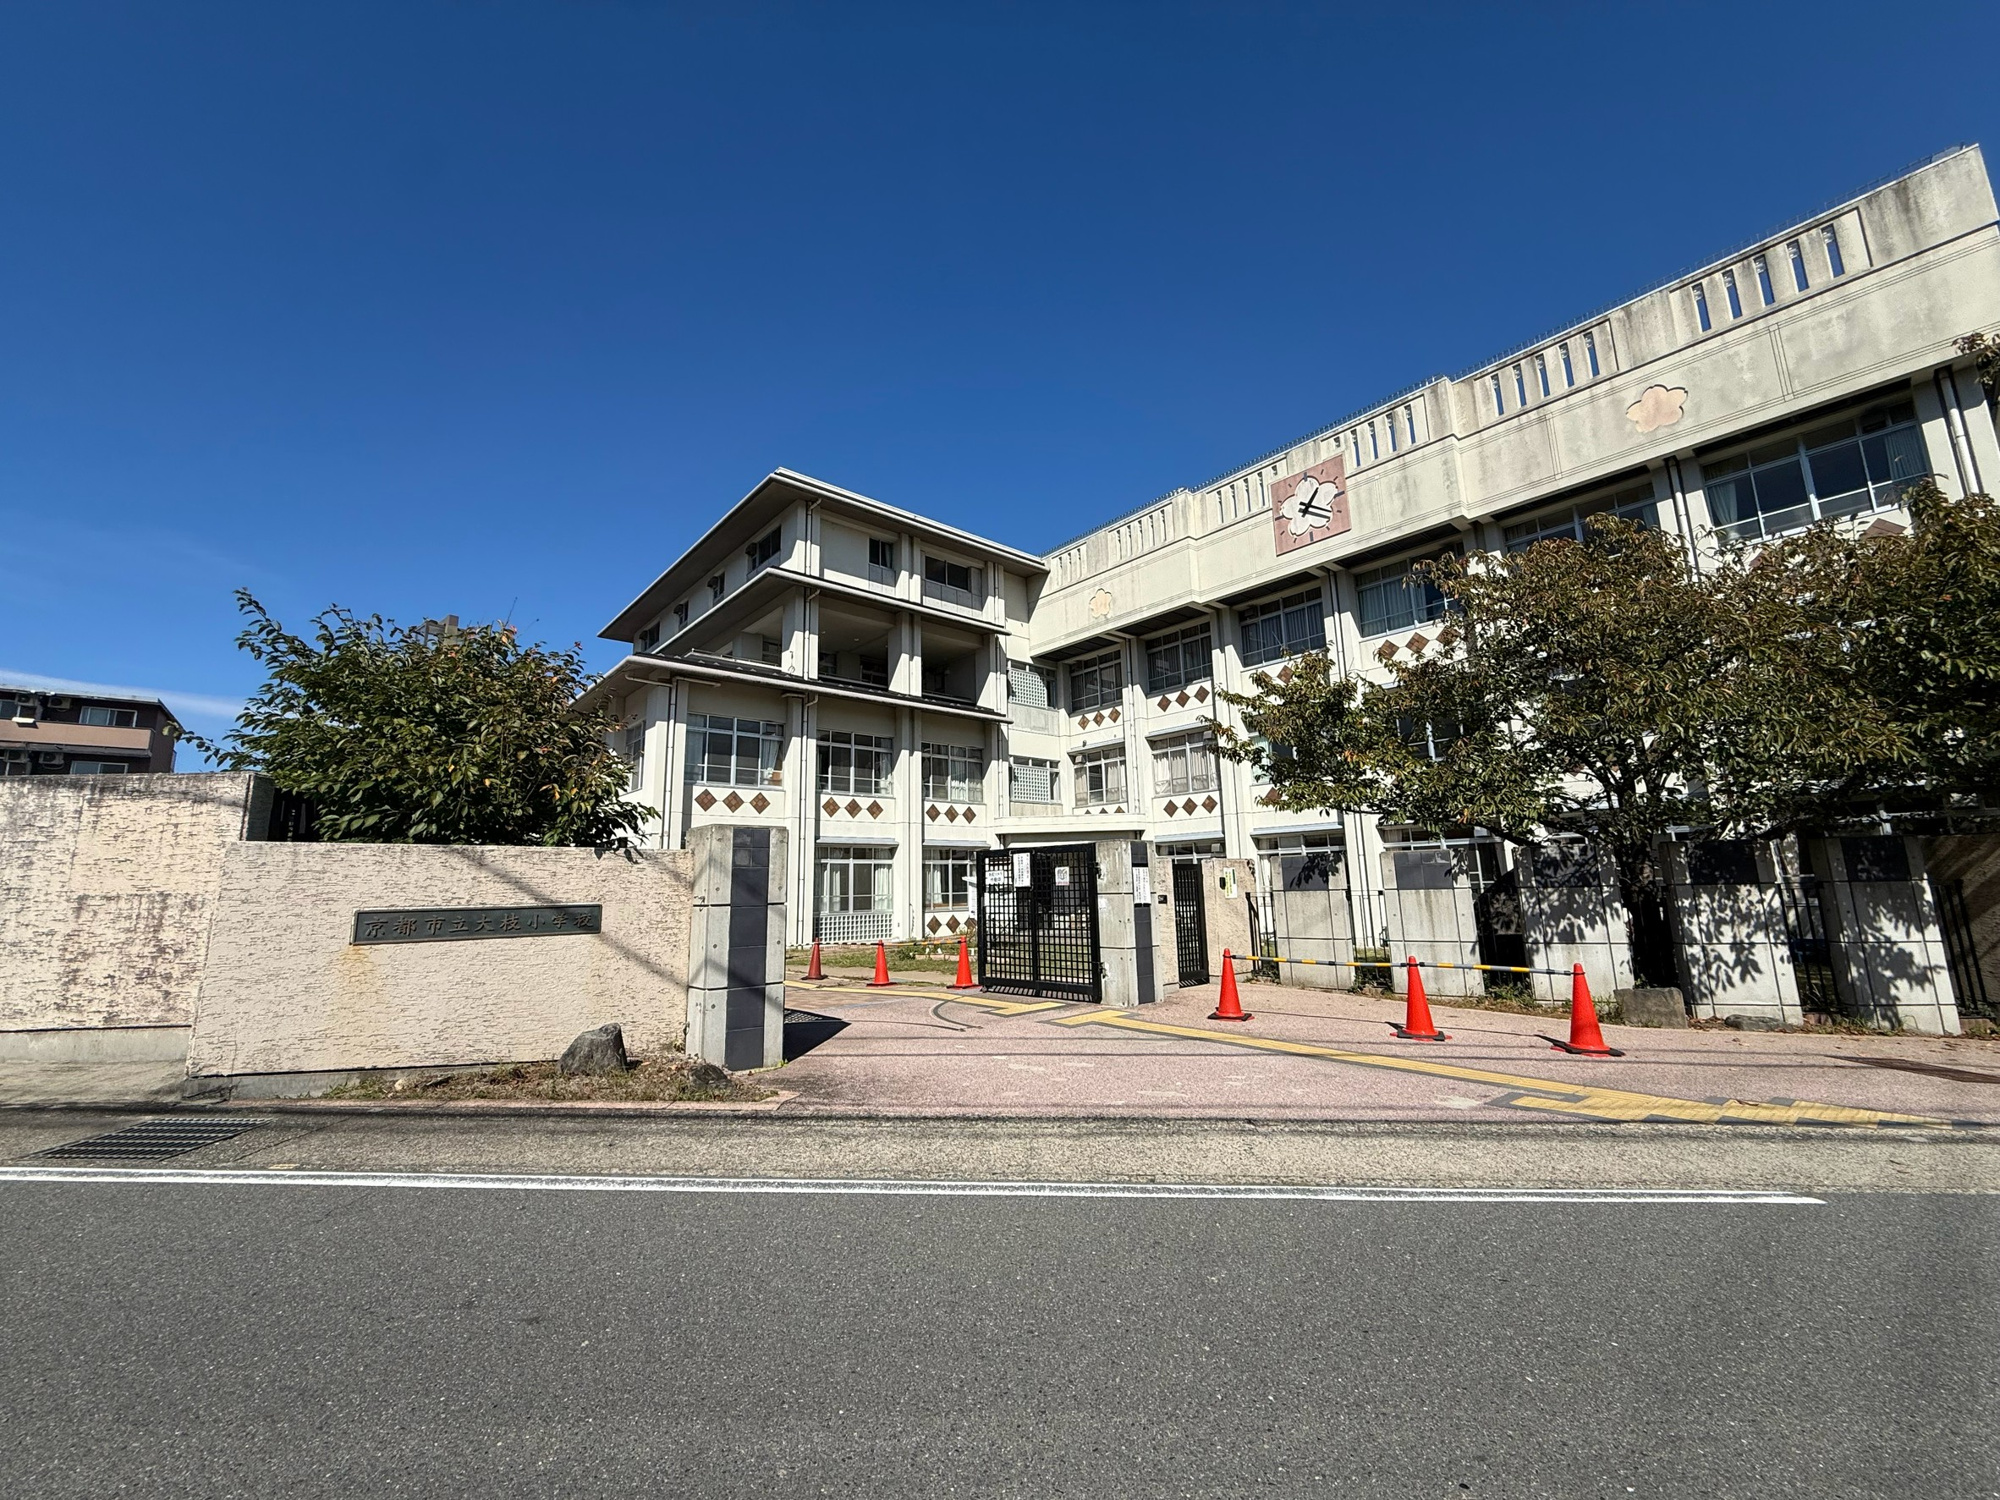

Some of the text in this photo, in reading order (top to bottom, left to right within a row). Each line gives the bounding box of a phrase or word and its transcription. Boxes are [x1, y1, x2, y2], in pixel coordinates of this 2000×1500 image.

[364, 912, 595, 938] 京都市立大枝小学校
